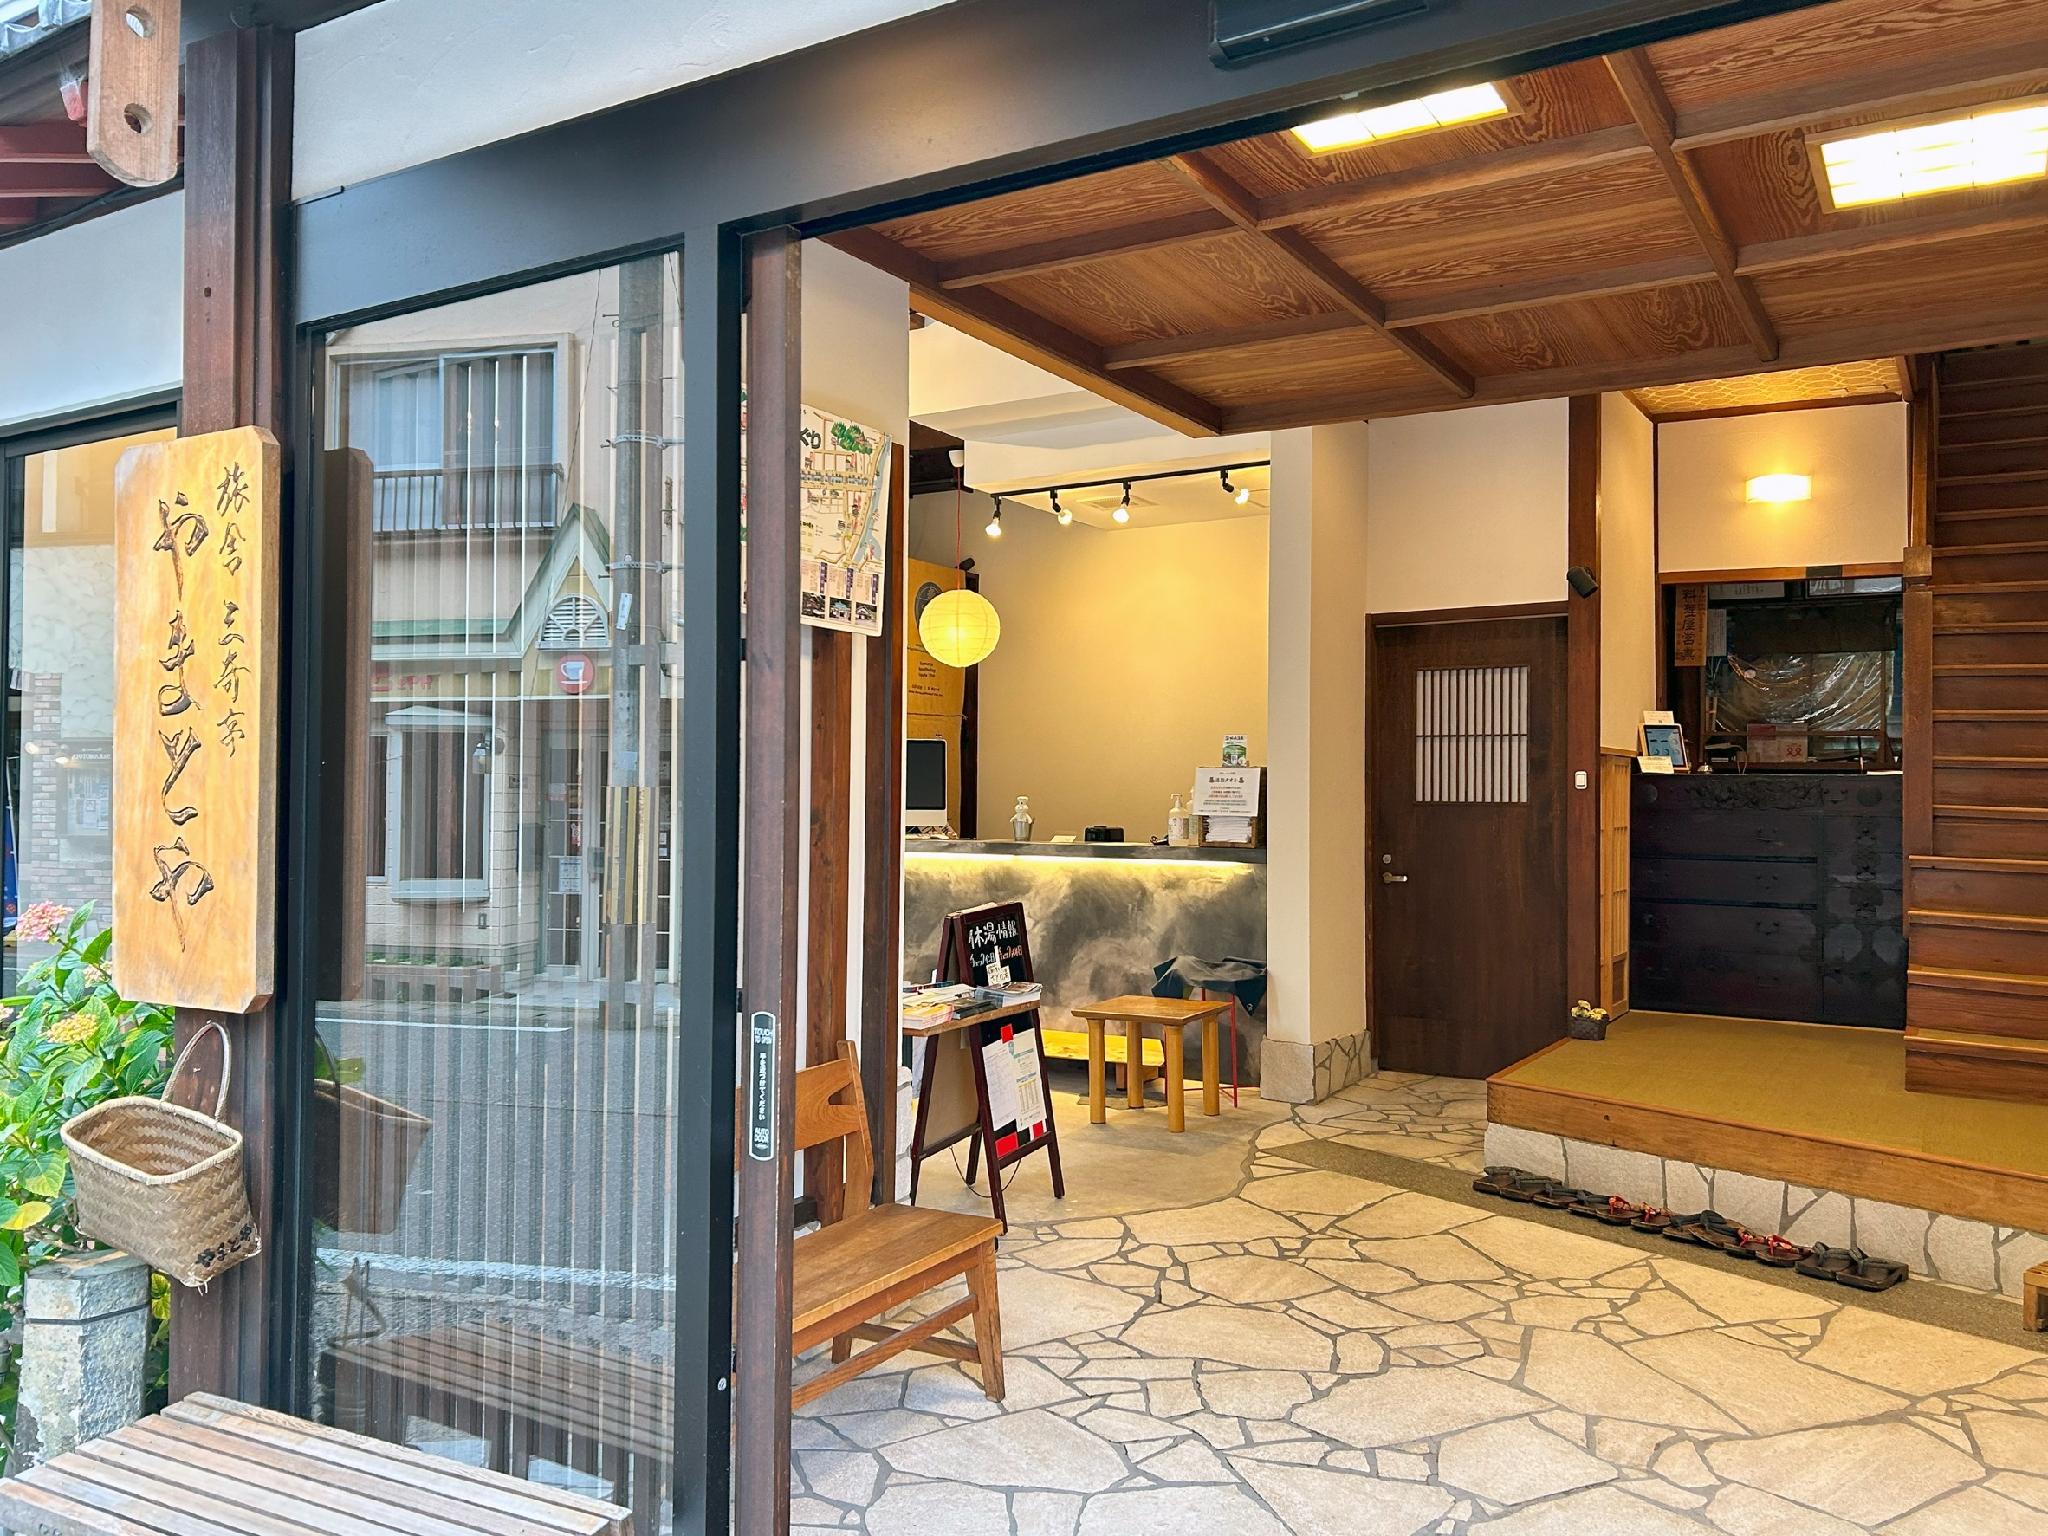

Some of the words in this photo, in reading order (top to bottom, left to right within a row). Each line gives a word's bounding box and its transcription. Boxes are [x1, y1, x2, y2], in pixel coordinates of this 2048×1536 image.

[149, 490, 215, 953] やまとや
[969, 920, 1017, 949] 休湯情報
